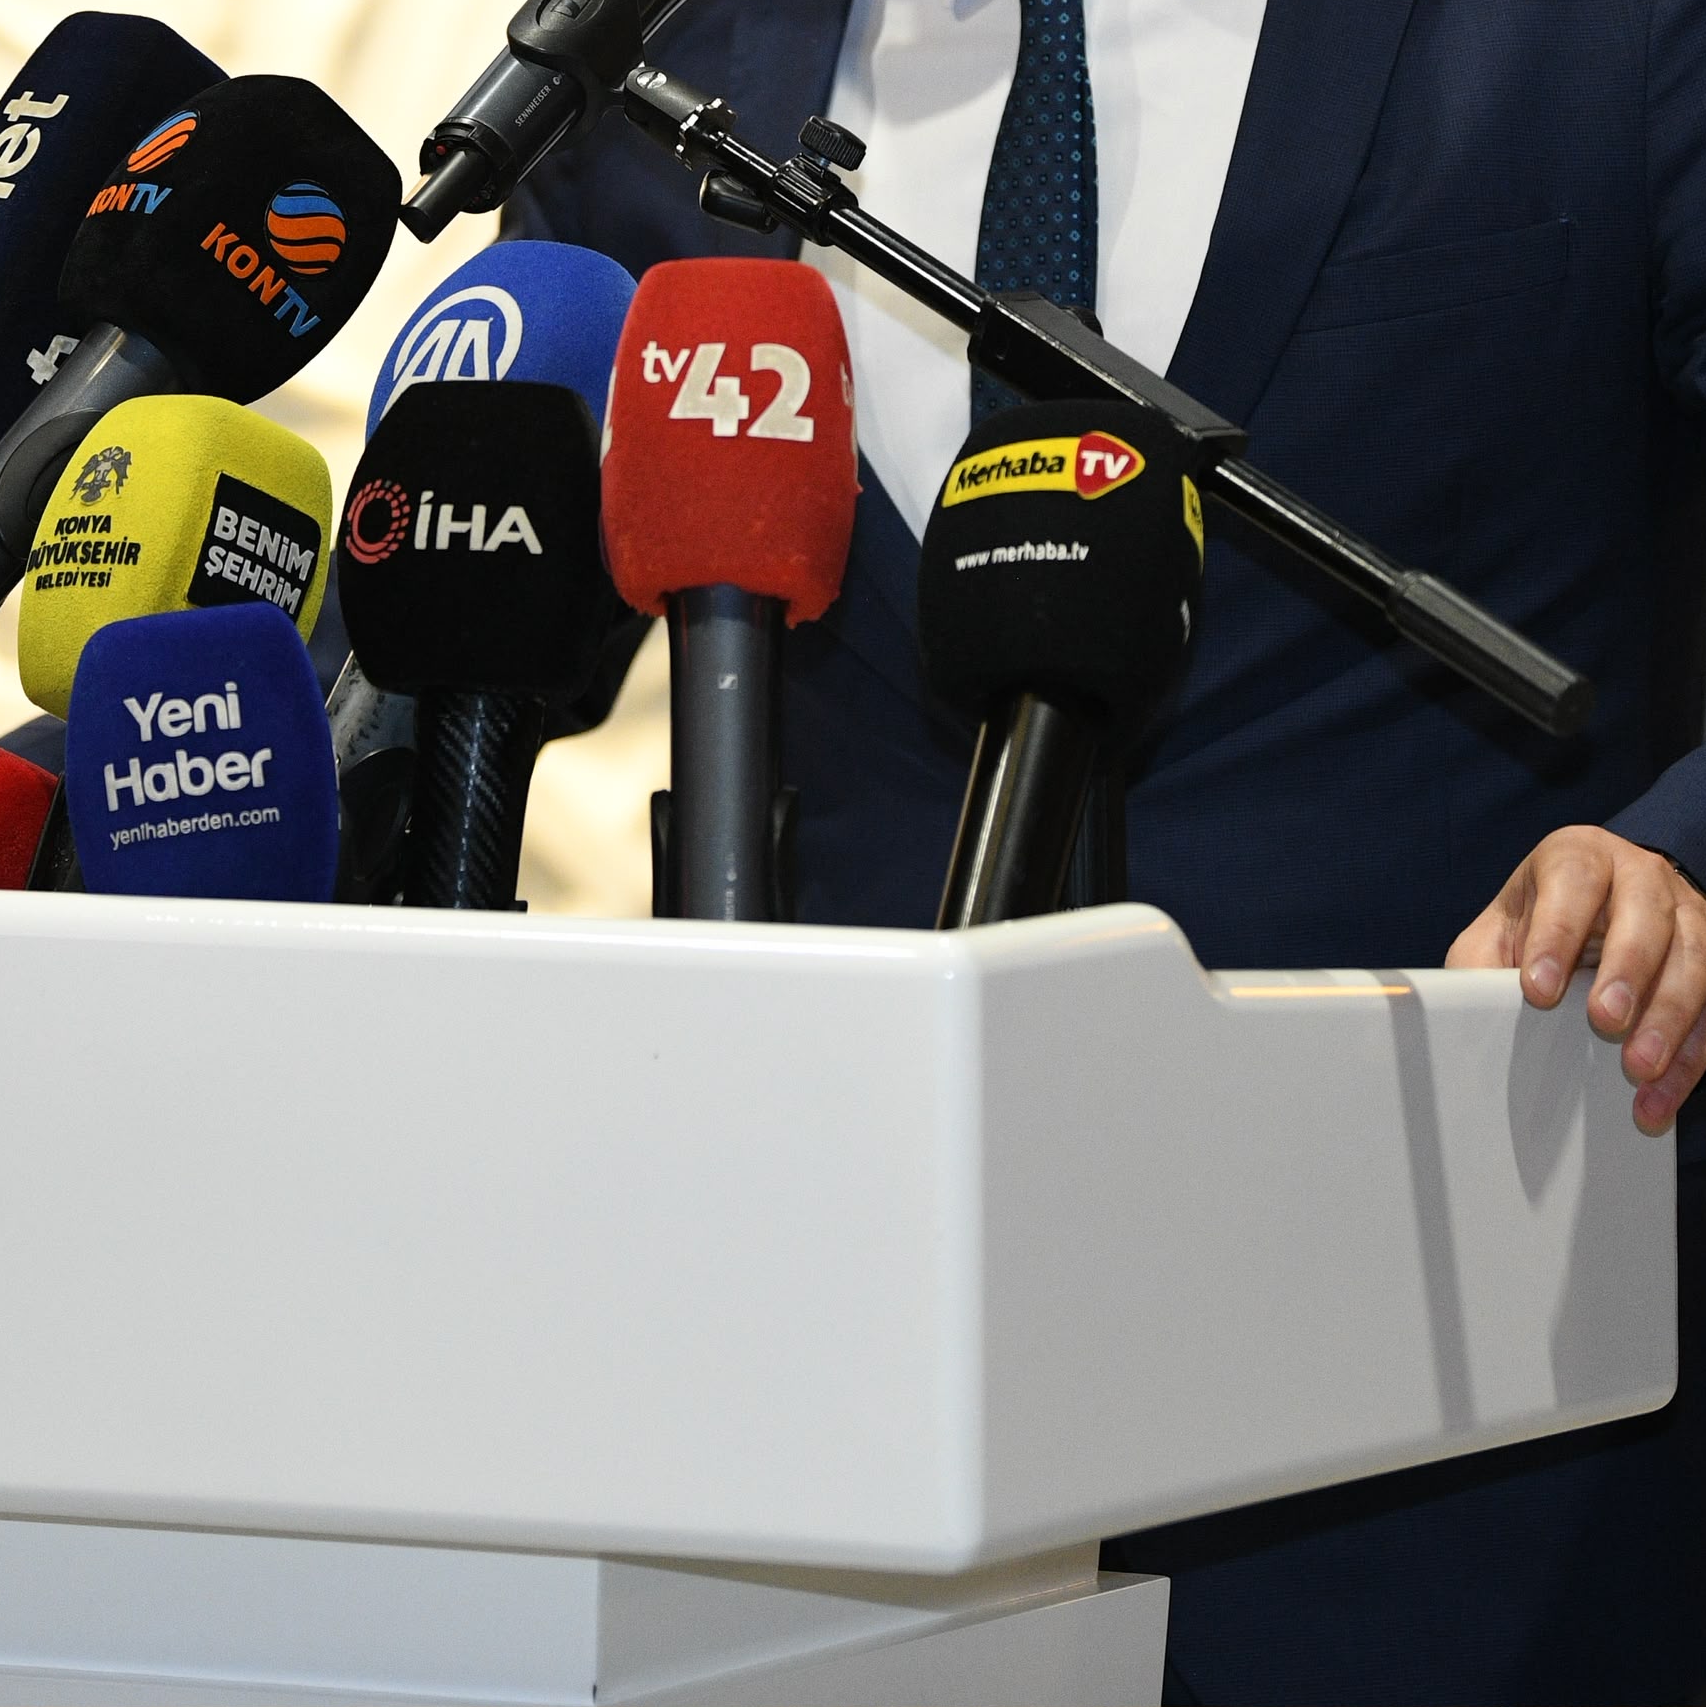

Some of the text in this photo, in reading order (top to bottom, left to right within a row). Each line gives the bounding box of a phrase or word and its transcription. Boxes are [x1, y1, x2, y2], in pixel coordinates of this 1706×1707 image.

[514, 84, 552, 127] SENNHEISER
[200, 222, 321, 338] KONTV
[955, 450, 1130, 493] Merhaba TV
[54, 515, 111, 536] KONYA
[123, 682, 242, 743] Yeni
[103, 748, 272, 813] Haber
[109, 806, 281, 851] yenihaberden.com
